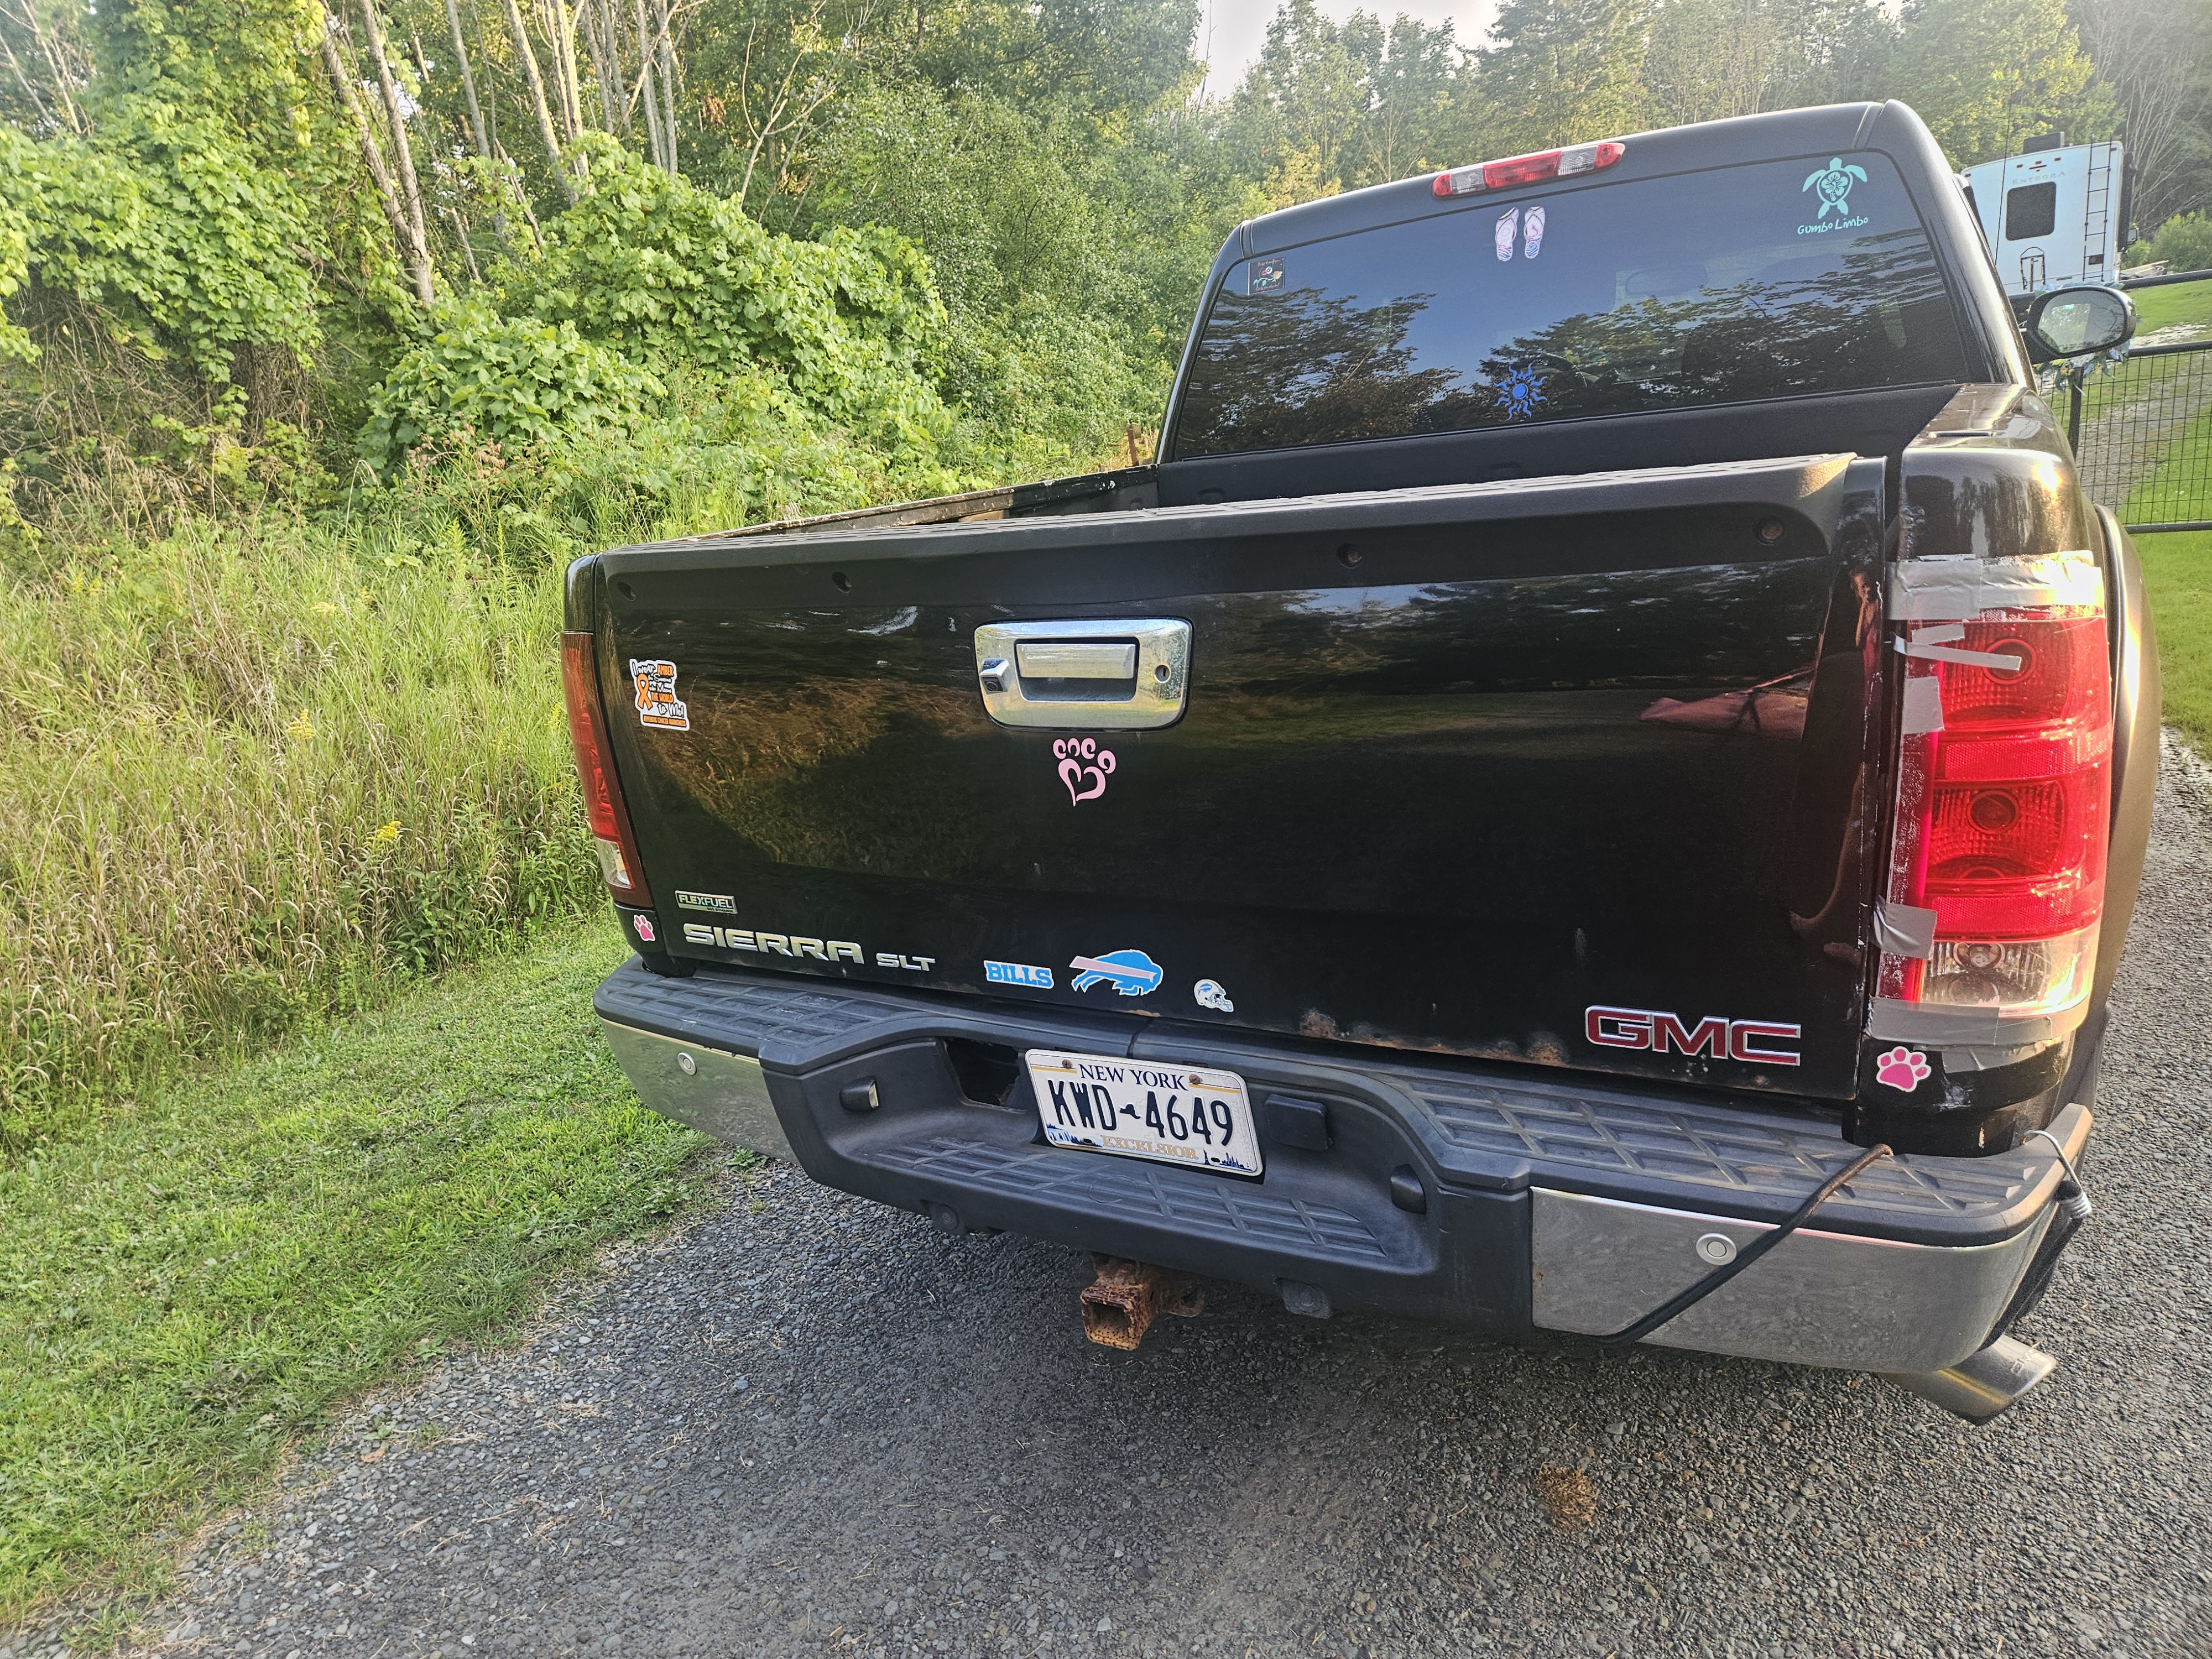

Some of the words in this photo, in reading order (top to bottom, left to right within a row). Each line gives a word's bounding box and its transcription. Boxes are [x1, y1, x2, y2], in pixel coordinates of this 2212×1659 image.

[1797, 222, 1833, 234] Gumbo
[1835, 216, 1869, 229] Limbo
[638, 664, 655, 675] wear
[658, 664, 674, 676] AMBER
[659, 693, 674, 703] WORLD
[657, 703, 667, 714] to
[668, 702, 684, 718] Me!
[678, 894, 733, 909] FLEXFUEL
[683, 923, 864, 964] SIERRA
[875, 952, 936, 971] SLT
[986, 963, 1052, 986] BILLS
[1585, 1005, 1802, 1067] GMC
[1078, 1063, 1125, 1083] NEW
[1128, 1069, 1189, 1091] YORK
[1100, 1135, 1199, 1160] EXCELSIOR
